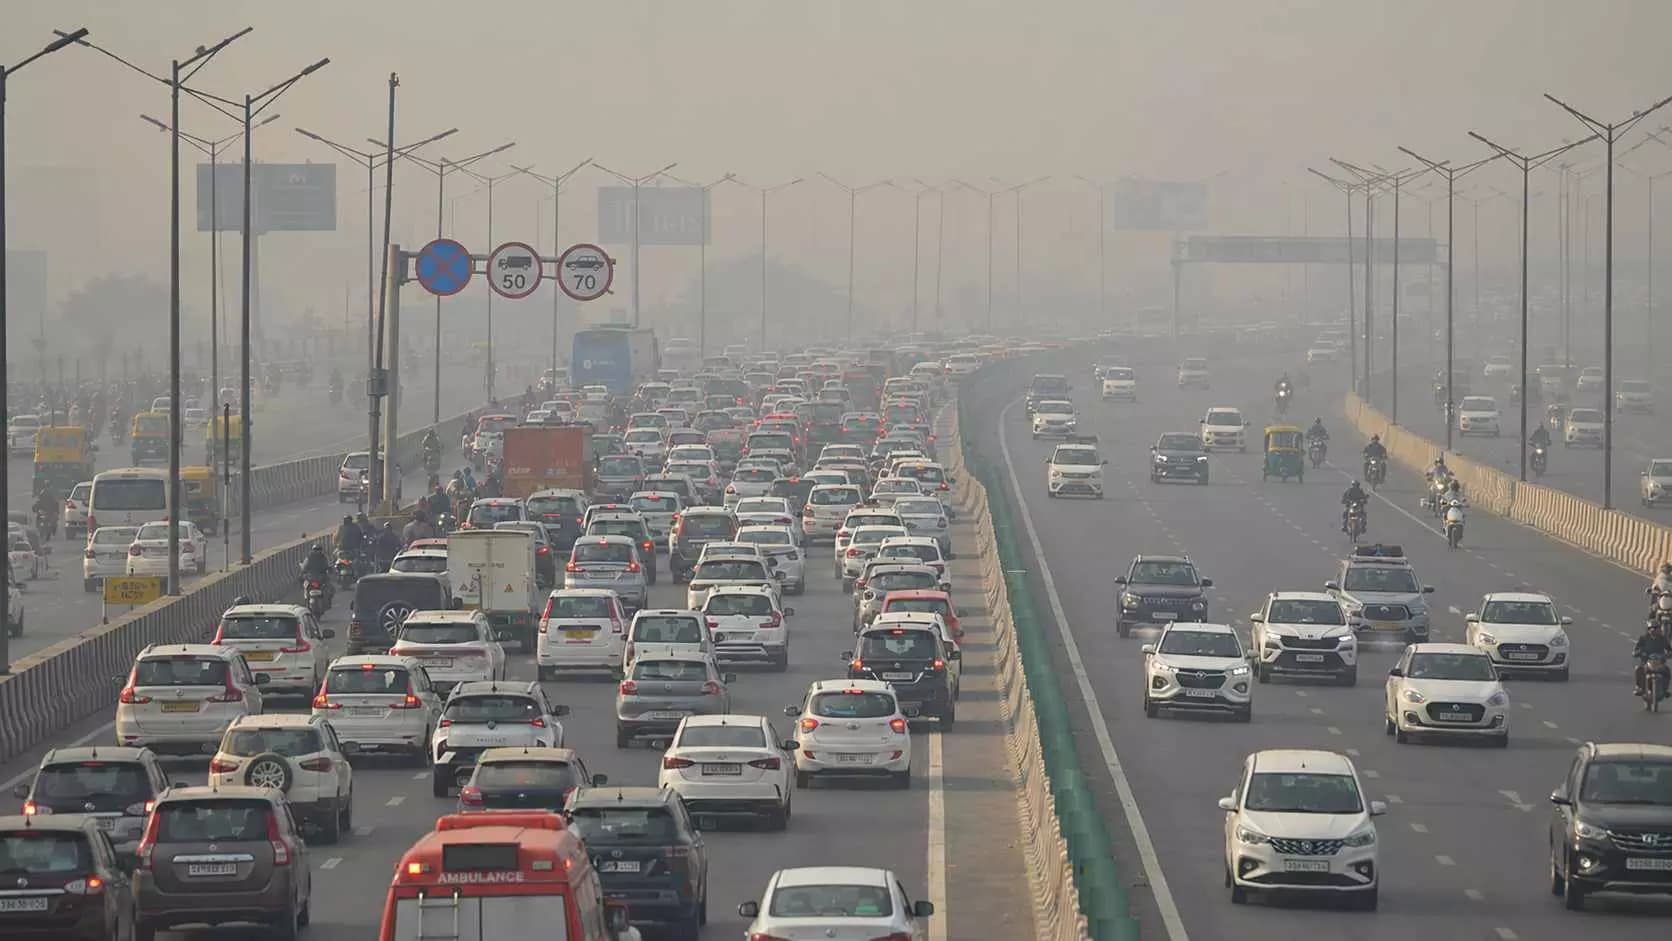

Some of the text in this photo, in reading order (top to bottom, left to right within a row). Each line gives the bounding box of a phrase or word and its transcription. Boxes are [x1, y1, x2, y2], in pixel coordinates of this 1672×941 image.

[503, 274, 525, 289] 50
[574, 275, 596, 290] 70
[438, 871, 525, 884] AMBULANCE
